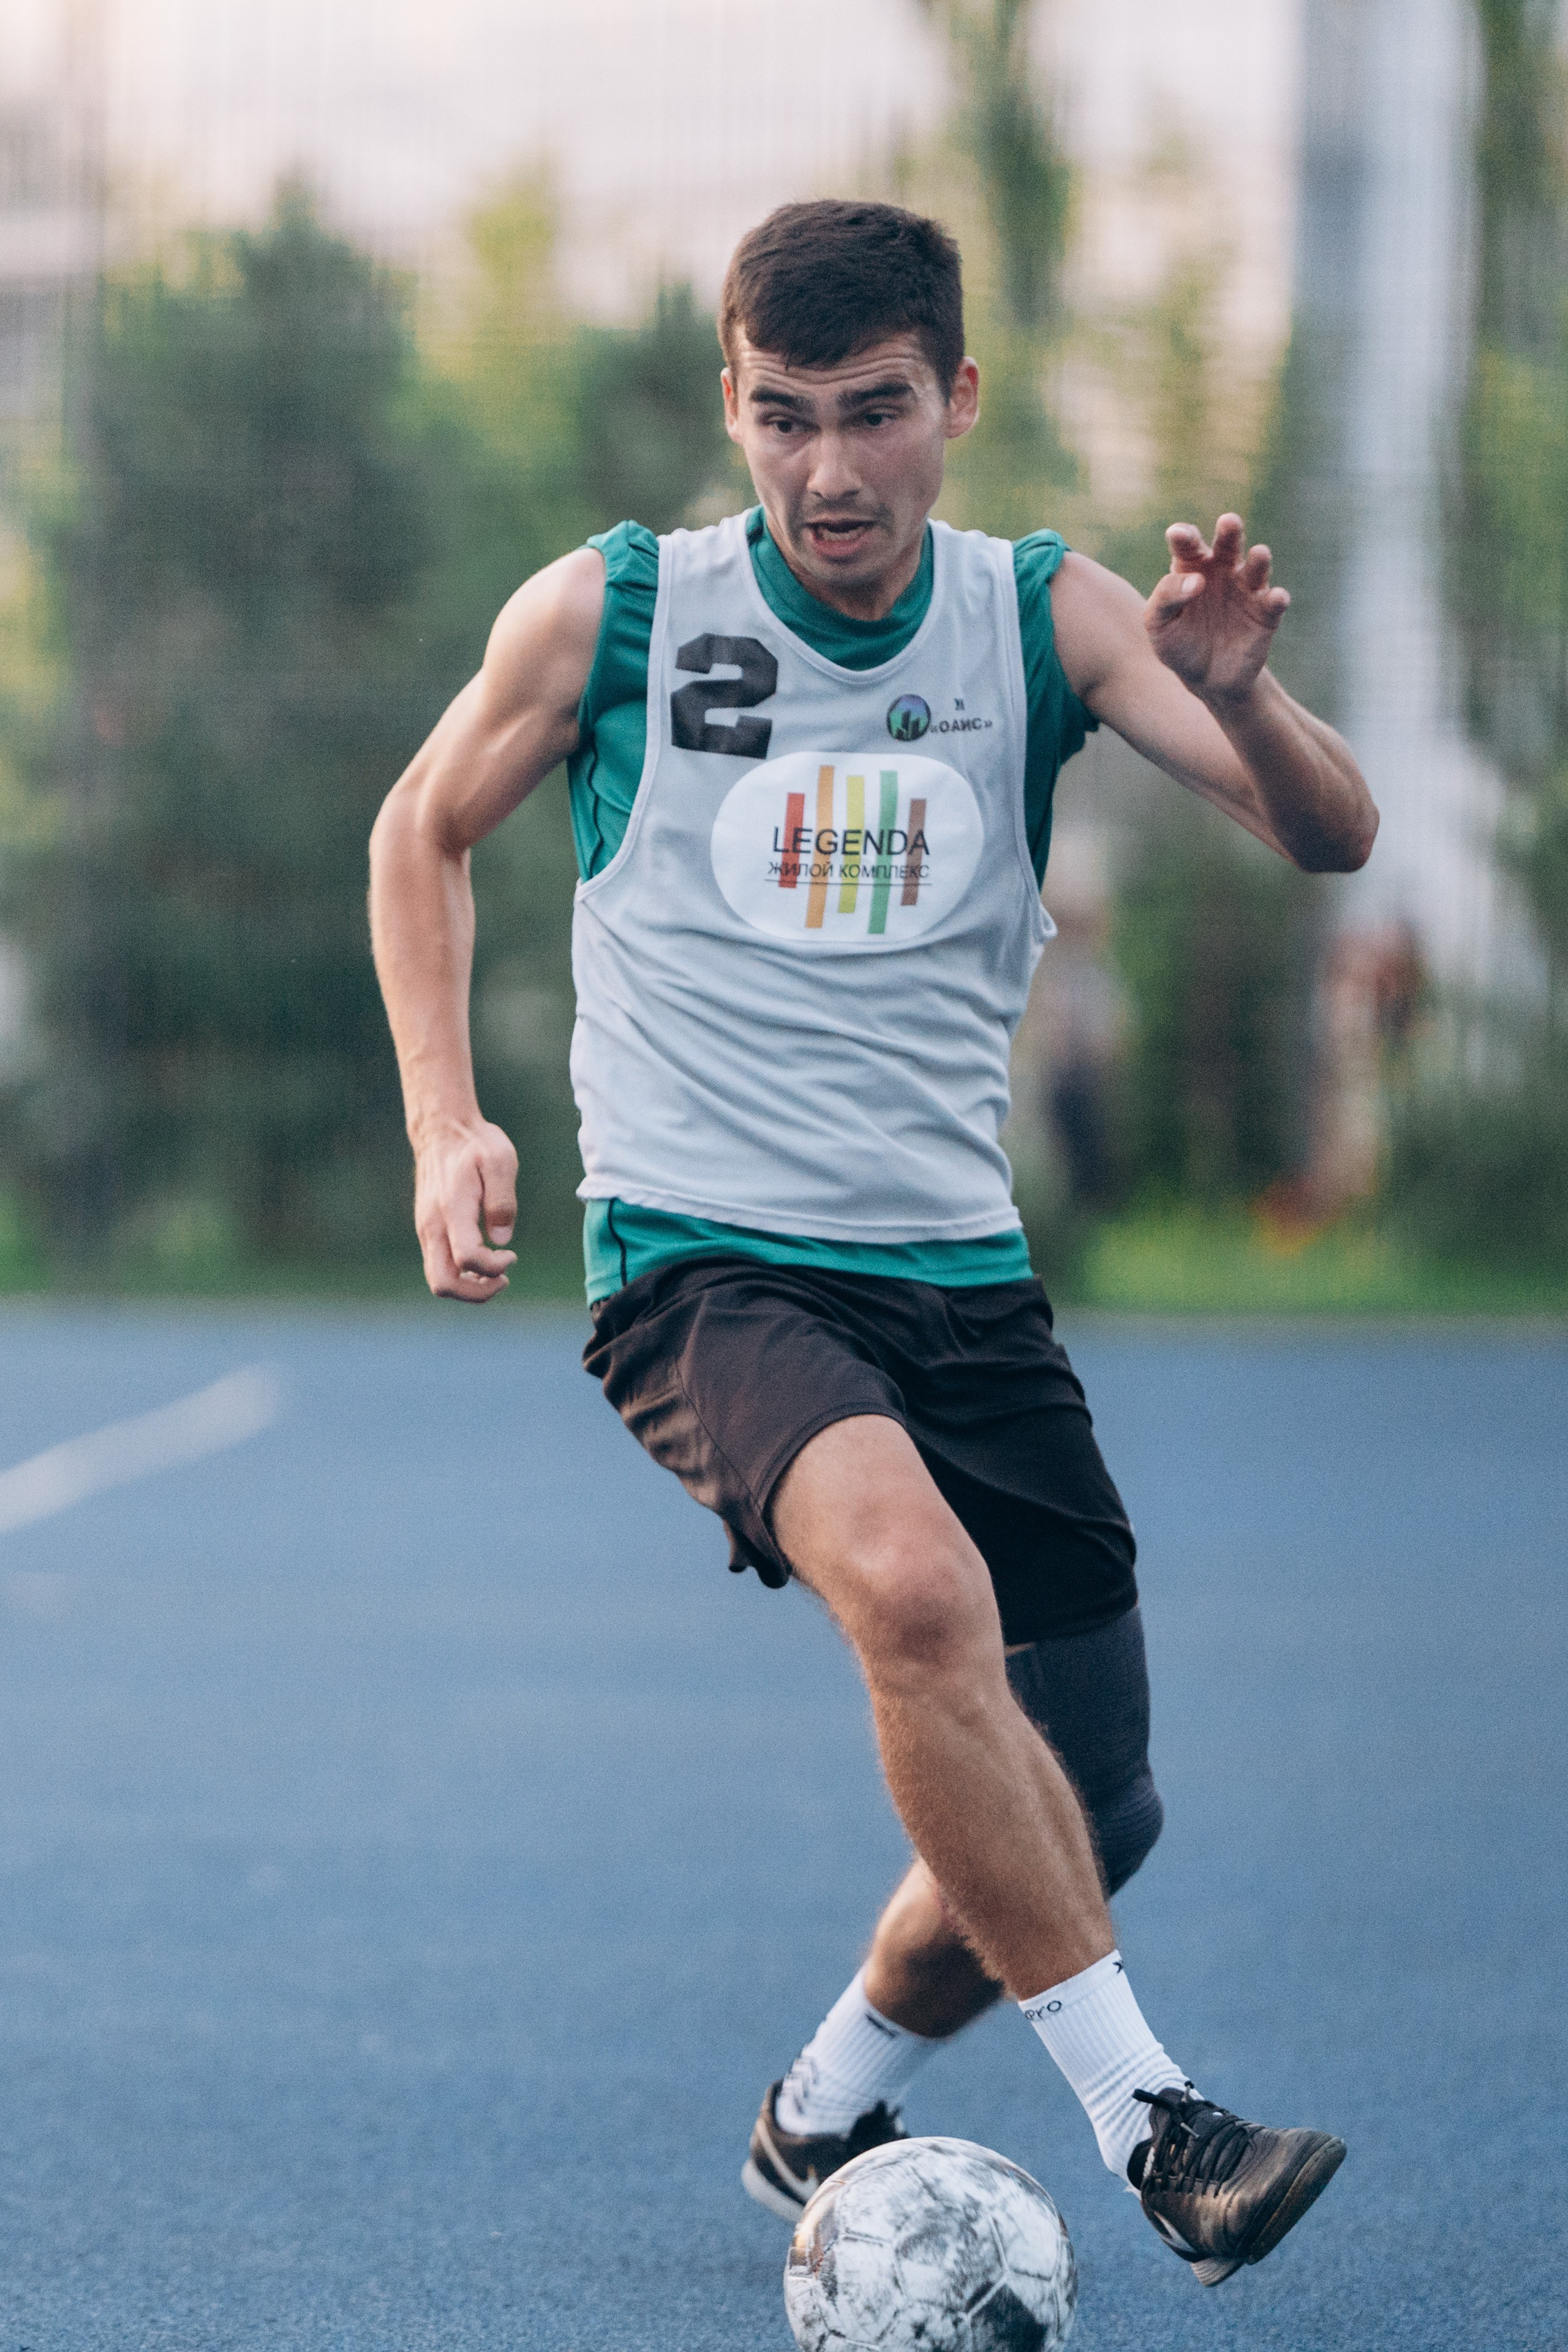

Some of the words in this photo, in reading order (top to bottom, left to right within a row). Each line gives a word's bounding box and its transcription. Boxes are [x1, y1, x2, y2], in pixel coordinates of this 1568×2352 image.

[671, 633, 778, 760] 2
[772, 826, 930, 856] LEGENDA
[767, 861, 832, 878] ЖИЛОЙ
[839, 863, 930, 880] КОМПЛЕКС
